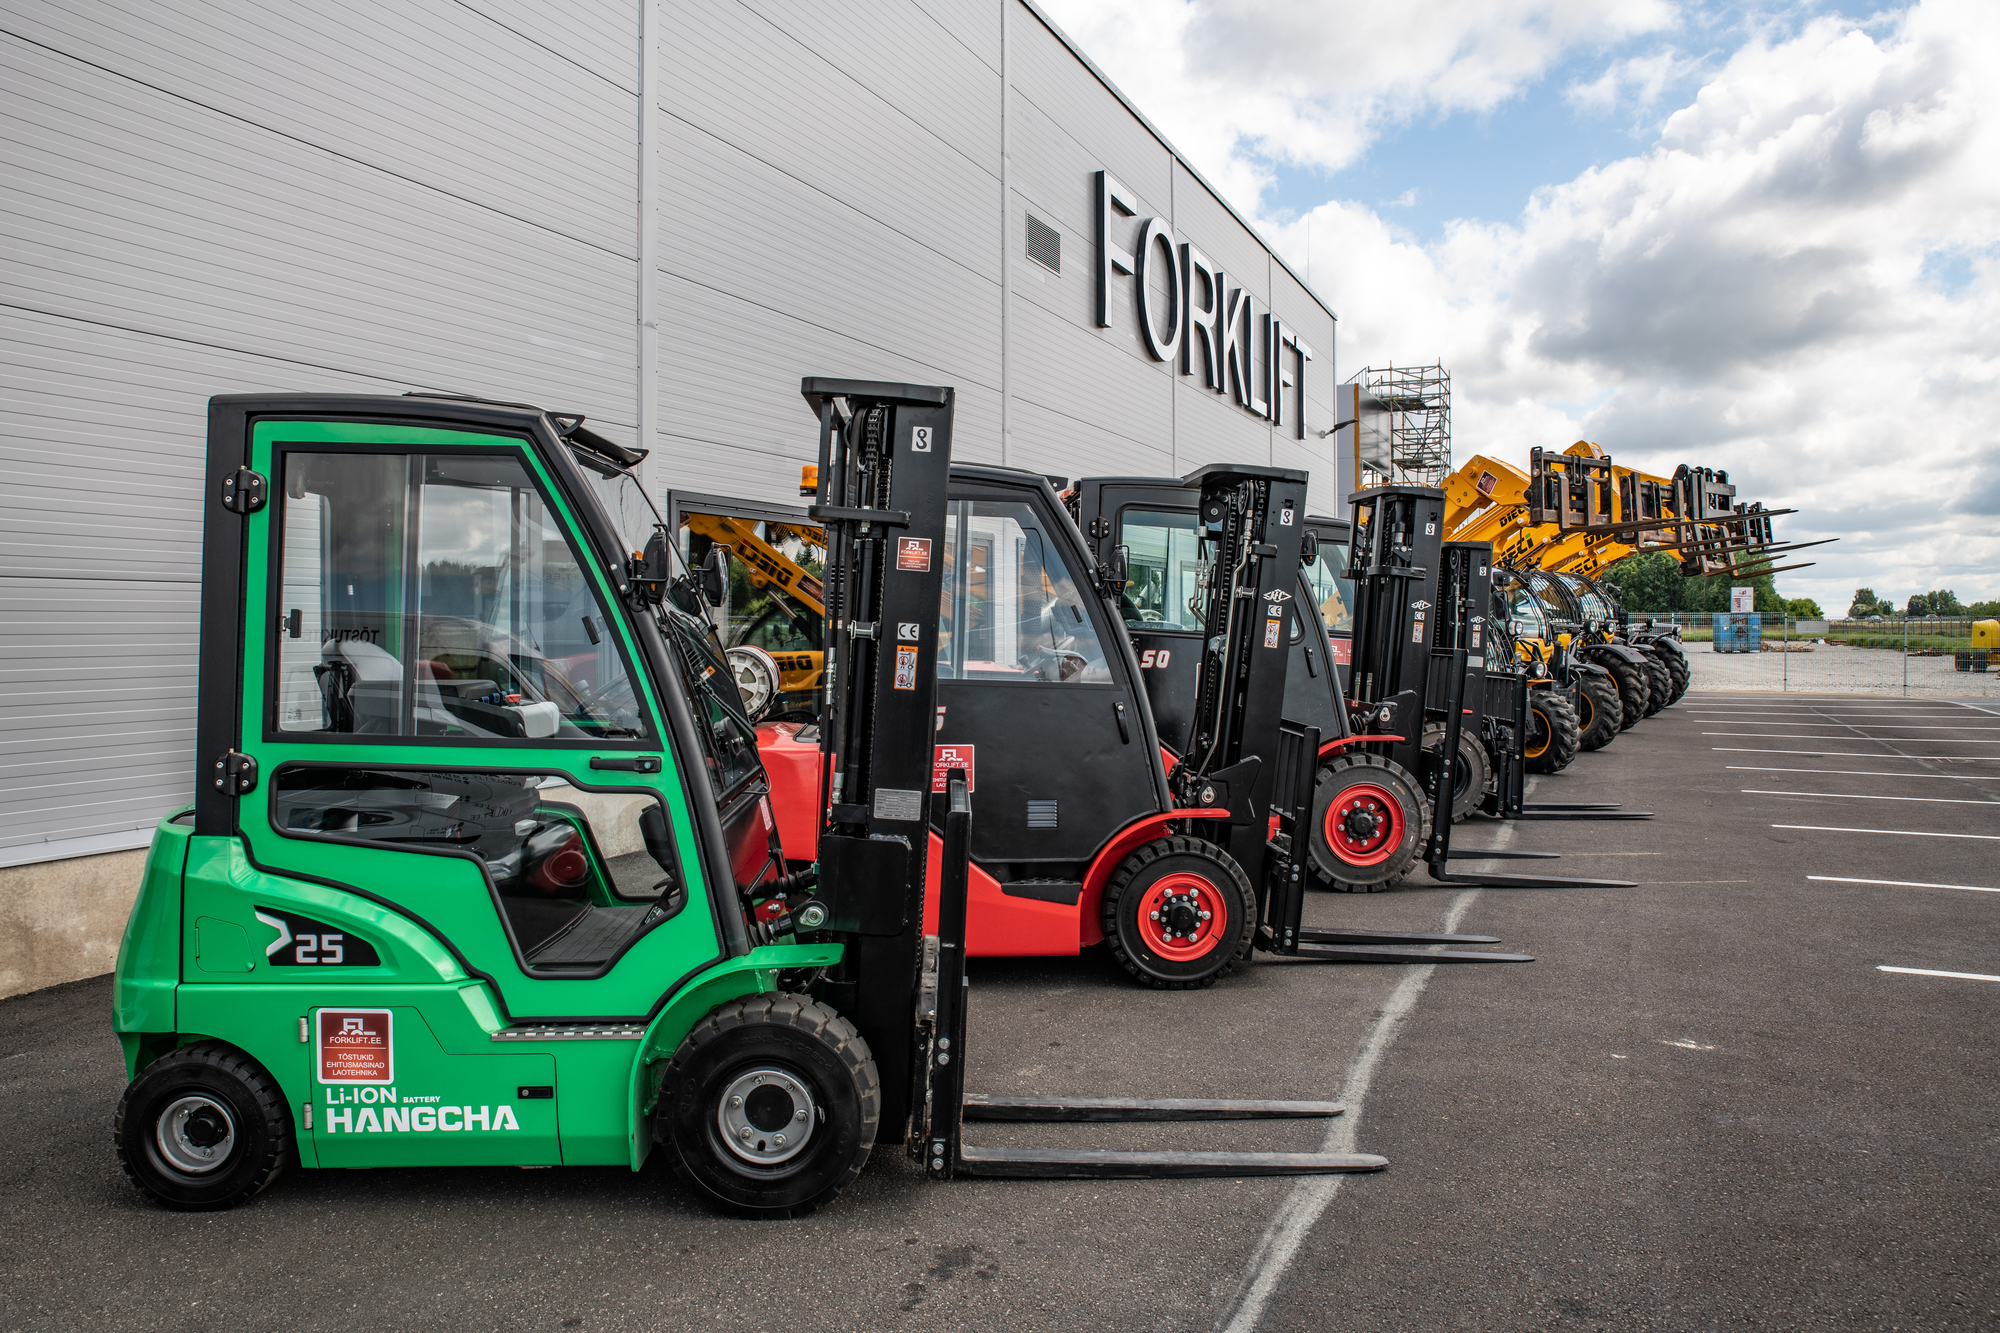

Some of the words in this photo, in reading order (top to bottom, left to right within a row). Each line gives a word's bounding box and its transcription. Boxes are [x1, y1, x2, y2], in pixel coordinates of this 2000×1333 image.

[1095, 170, 1312, 440] FORKLIFT
[899, 624, 918, 639] CE
[1140, 649, 1171, 669] 50
[295, 934, 343, 963] 25
[329, 1036, 382, 1045] FORKLIFT.EE
[326, 1061, 385, 1069] EHITUSMASINAD
[326, 1086, 397, 1105] Li-ION
[402, 1096, 441, 1104] BATTERY
[326, 1105, 520, 1133] HANGCHA
